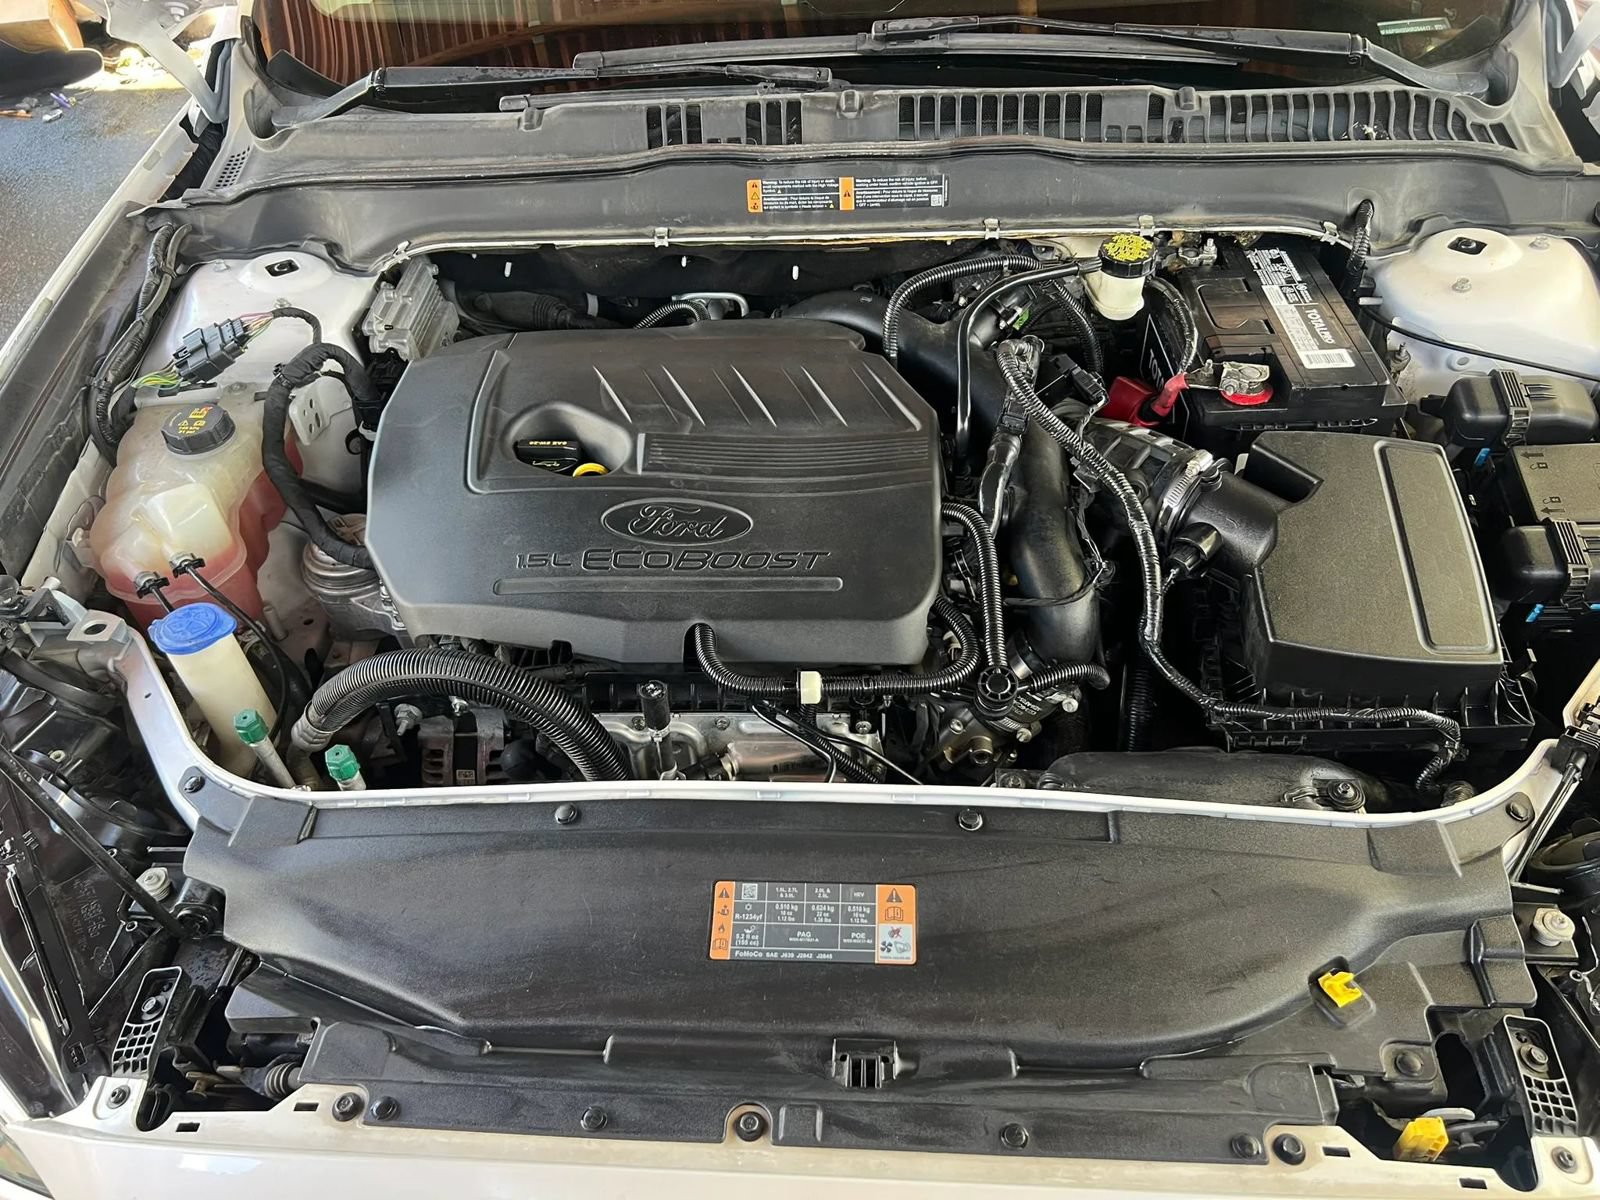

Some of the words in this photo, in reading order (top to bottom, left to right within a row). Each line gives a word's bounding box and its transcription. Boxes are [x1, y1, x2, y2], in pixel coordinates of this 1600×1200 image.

[628, 505, 728, 538] Ford
[516, 552, 572, 570] 1.5L
[791, 904, 798, 912] kg
[735, 913, 762, 922] R-1234yf
